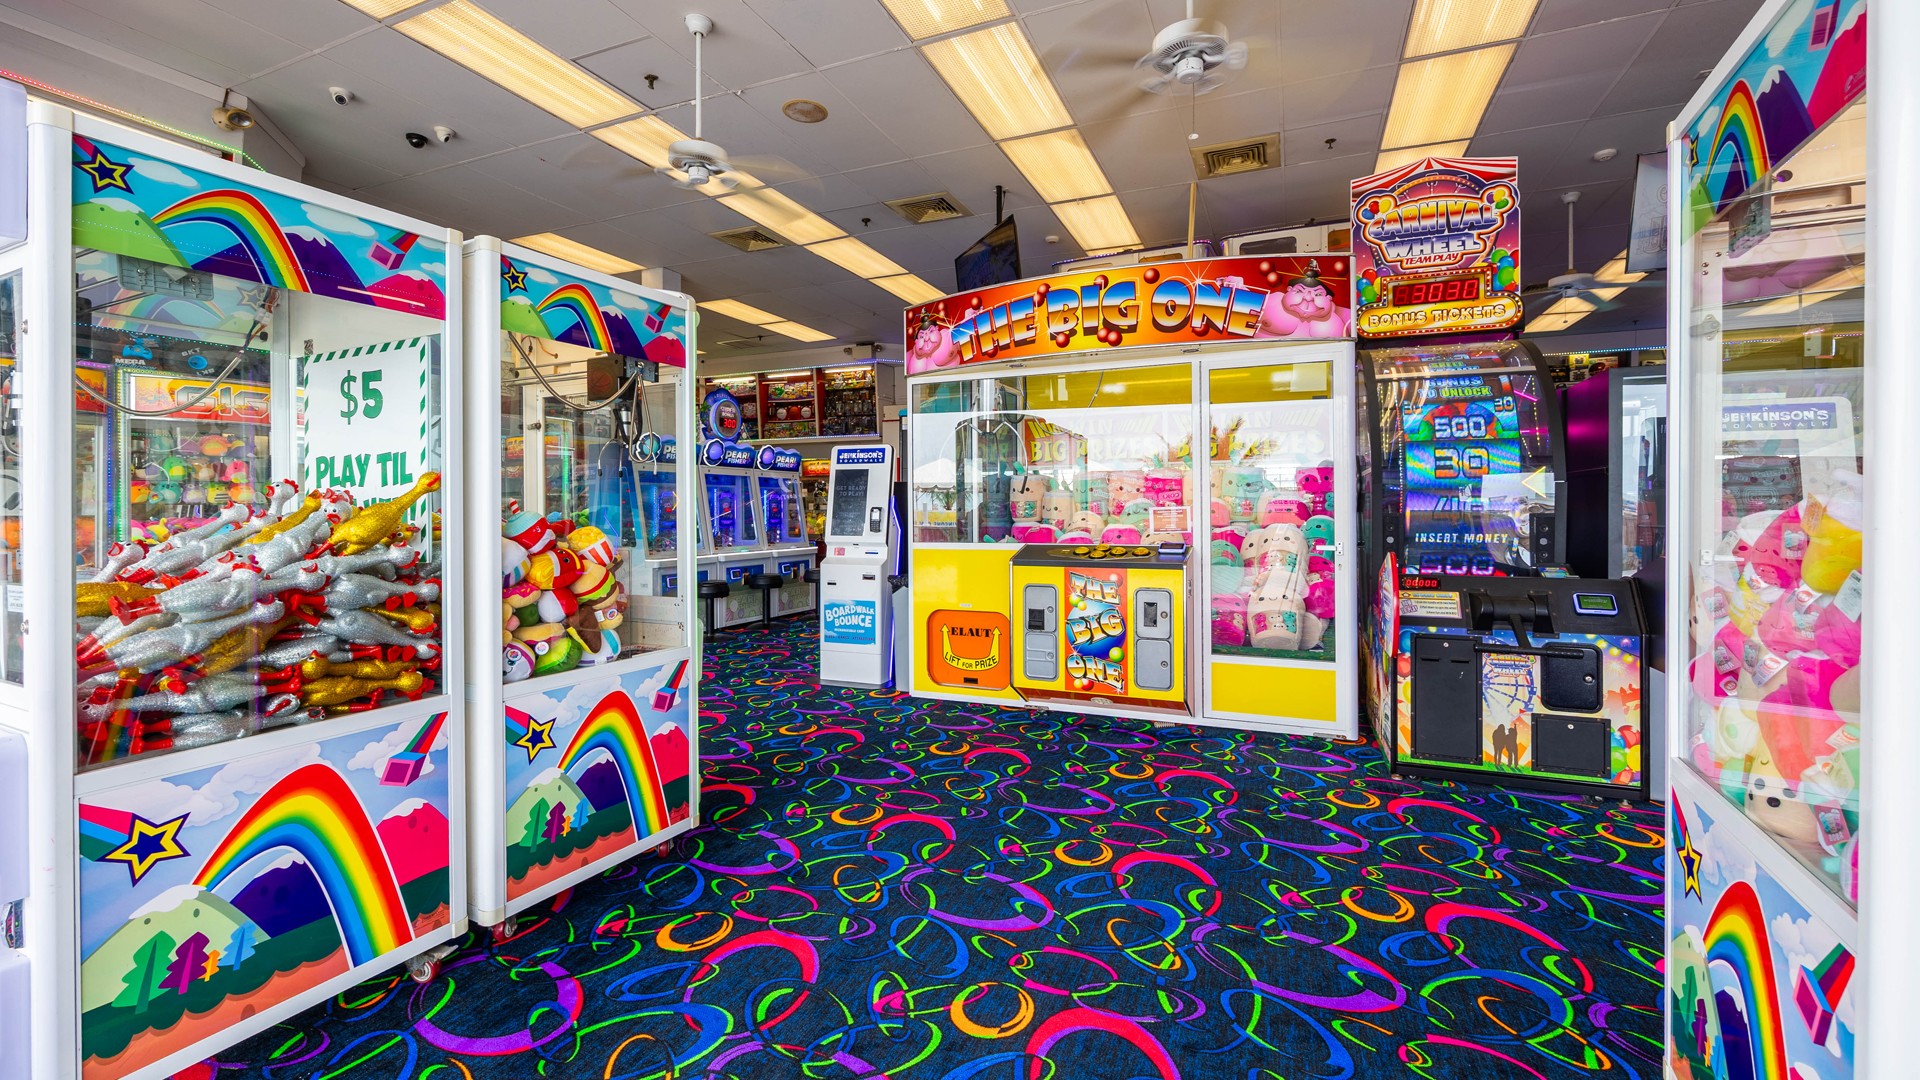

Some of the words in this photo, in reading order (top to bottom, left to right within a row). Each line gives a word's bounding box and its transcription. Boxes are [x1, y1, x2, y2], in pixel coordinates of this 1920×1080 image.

[1368, 200, 1500, 237] CARNIVAL
[1385, 233, 1481, 258] WHEEL
[1404, 257, 1432, 266] TEAM
[1433, 252, 1459, 263] PLAY
[951, 297, 1038, 361] THE
[1046, 279, 1142, 332] BIG
[1152, 276, 1270, 338] ONE
[1368, 311, 1427, 327] BONUS
[1432, 304, 1505, 322] TICKETS
[340, 369, 384, 426] $5
[1440, 386, 1493, 397] UNLOCK
[1494, 396, 1514, 412] 30
[723, 418, 737, 429] 300
[1434, 415, 1487, 438] 500
[1030, 440, 1067, 462] BIG
[1434, 446, 1489, 478] 30
[315, 453, 371, 488] PLAY
[377, 452, 413, 487] TIL
[1415, 533, 1459, 543] INSERT
[1464, 533, 1508, 543] MONEY
[1069, 571, 1121, 605] THE
[825, 605, 875, 622] BOARDWALK
[834, 615, 873, 627] BOUNCE
[951, 626, 991, 637] ELAUT
[1065, 608, 1125, 645] BIG
[944, 651, 960, 666] LIFT
[961, 661, 973, 669] FOR
[975, 655, 998, 669] PRIZE
[1066, 654, 1124, 691] ONE
